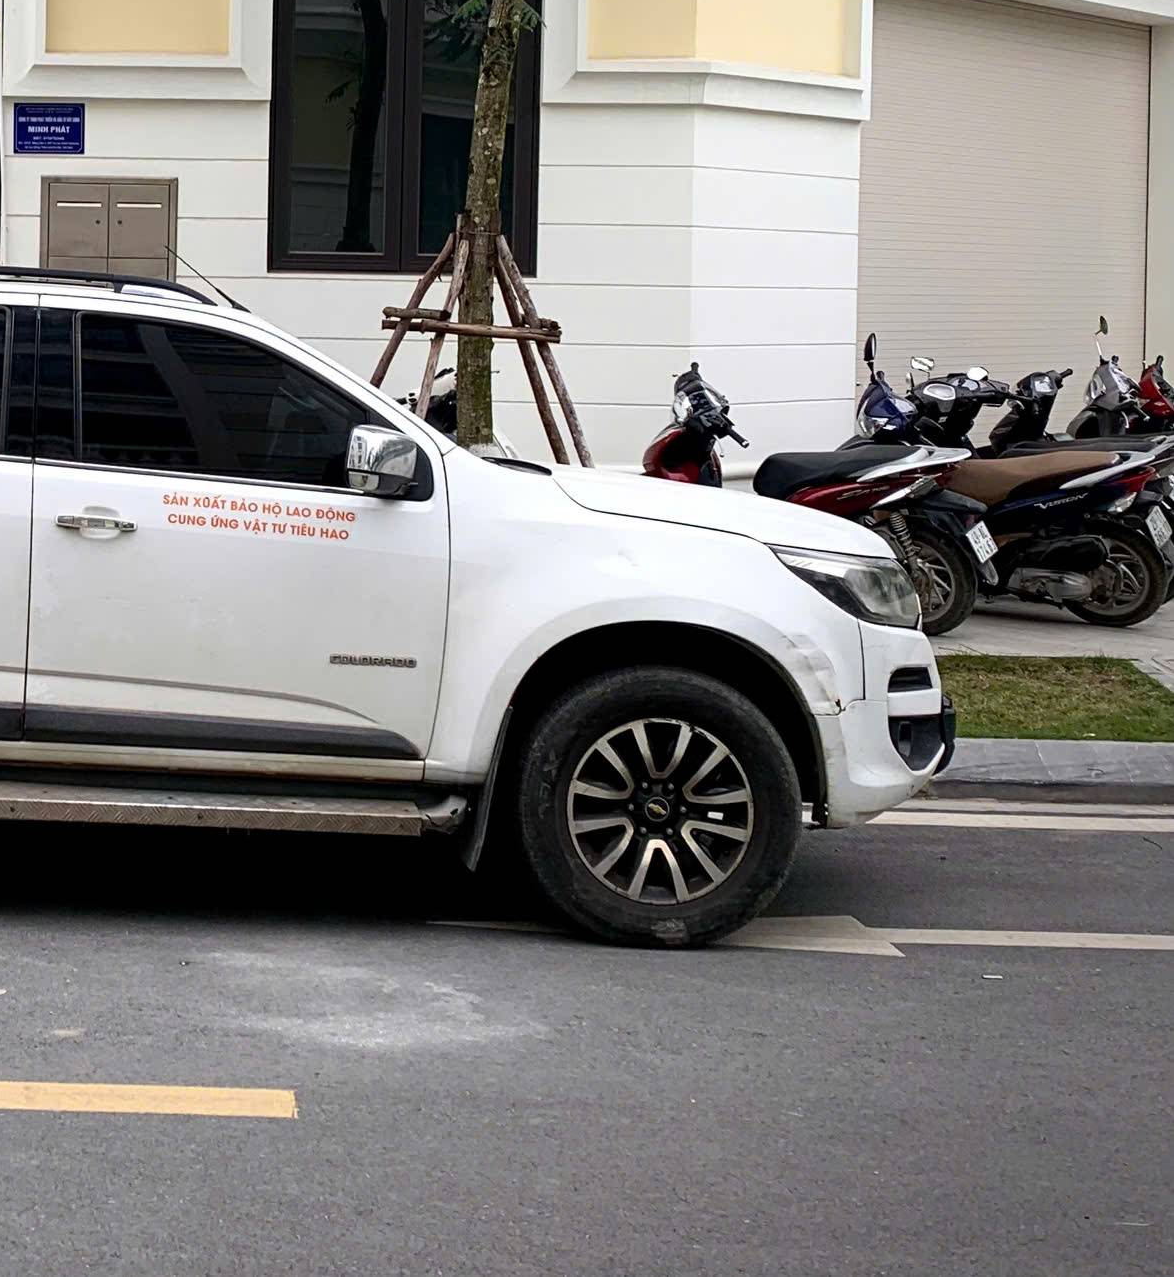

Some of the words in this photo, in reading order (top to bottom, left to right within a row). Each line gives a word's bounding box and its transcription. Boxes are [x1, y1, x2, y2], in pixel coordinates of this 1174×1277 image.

[163, 492, 189, 507] SẢN
[230, 498, 258, 513] BẢO
[262, 502, 282, 518] HỘ
[286, 506, 312, 518] LAO
[315, 507, 356, 522] ĐỘNG
[167, 513, 206, 526] CUNG
[210, 514, 239, 530] ỨNG
[243, 518, 267, 535] VẬT
[272, 522, 288, 535] TƯ
[290, 523, 316, 537] TIÊU
[320, 529, 349, 540] HAO
